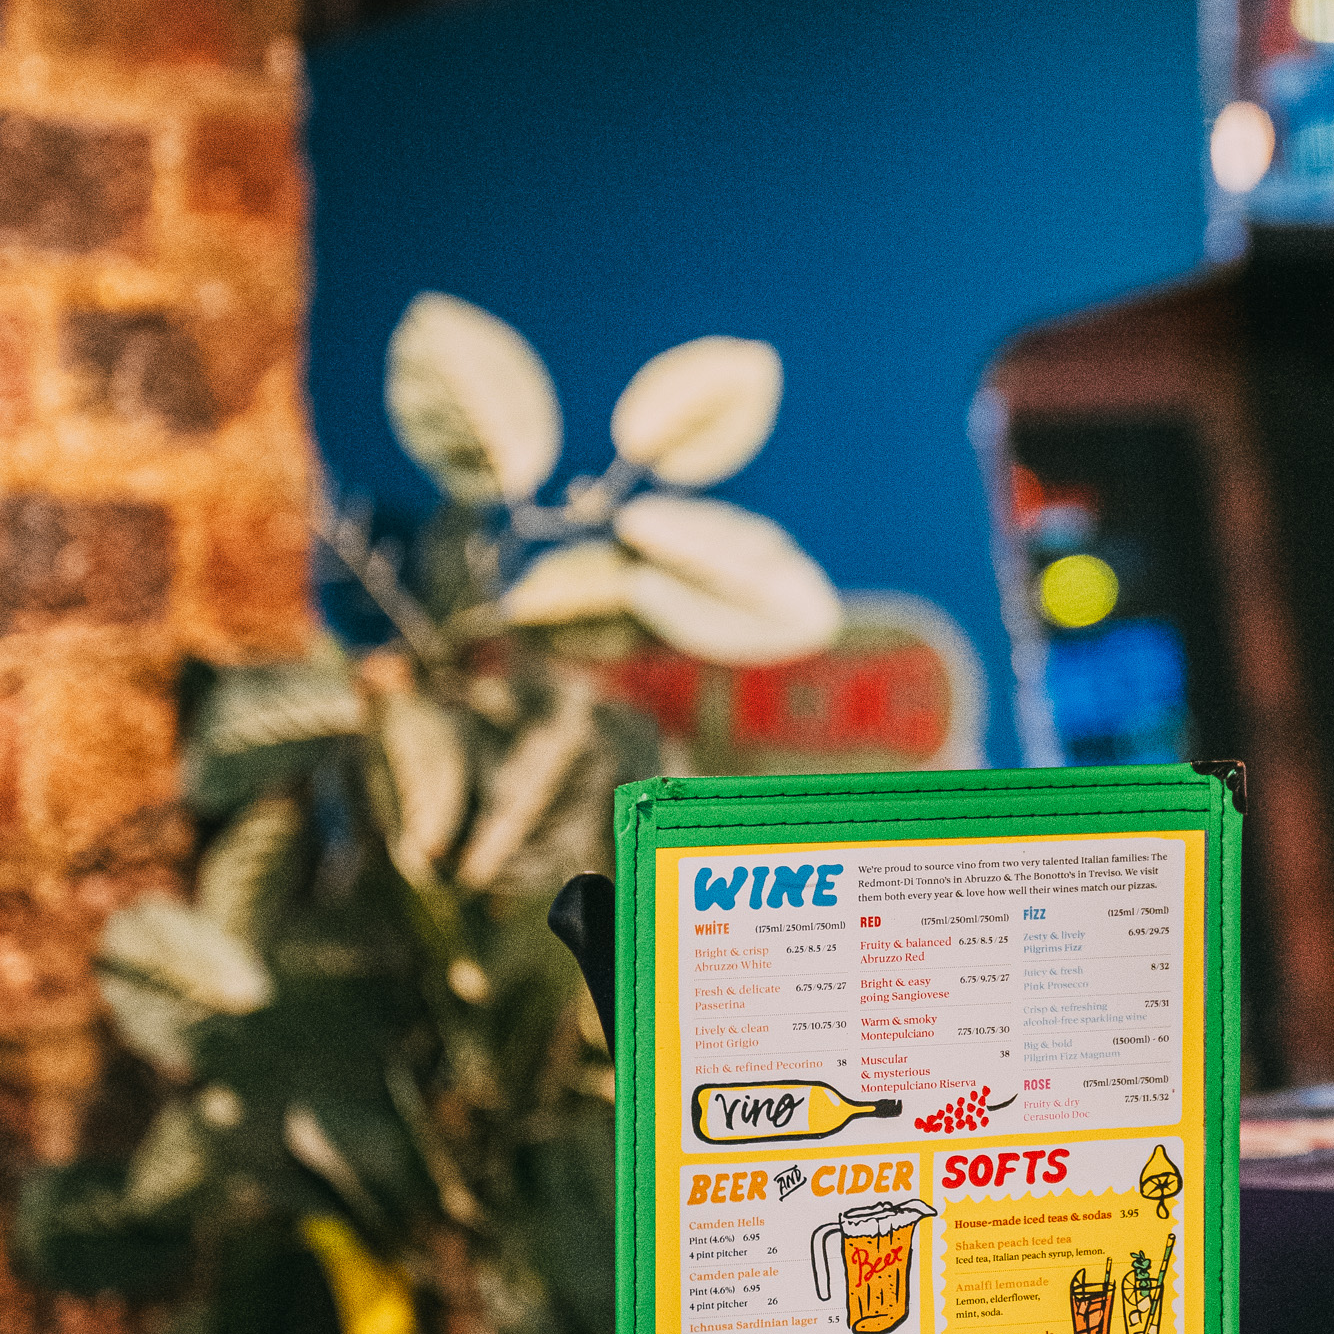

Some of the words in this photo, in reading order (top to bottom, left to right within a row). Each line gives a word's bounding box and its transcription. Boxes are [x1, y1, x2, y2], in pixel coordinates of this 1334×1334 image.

[884, 862, 911, 875] proud
[924, 863, 954, 871] source
[956, 861, 976, 869] vino
[978, 859, 1000, 869] from
[1020, 859, 1040, 868] very
[1042, 855, 1079, 866] talented
[1081, 855, 1109, 864] Italian
[1111, 853, 1149, 863] families:
[1150, 852, 1168, 861] The
[953, 875, 962, 884] in
[964, 874, 1002, 883] Abruzzo
[1003, 873, 1012, 882] &
[1014, 872, 1031, 881] The
[1077, 870, 1087, 878] in
[1088, 868, 1122, 878] Treviso.
[1124, 868, 1138, 876] We
[1139, 866, 1158, 875] visit
[694, 864, 843, 911] WINE
[857, 893, 882, 902] them
[884, 891, 906, 901] both
[907, 892, 932, 901] every
[934, 891, 953, 900] year
[954, 889, 964, 898] &
[966, 888, 985, 897] love
[987, 887, 1006, 896] how
[1008, 885, 1027, 895] well
[1029, 885, 1050, 894] their
[1052, 884, 1079, 893] wines
[1080, 882, 1109, 892] match
[1110, 883, 1126, 891] our
[1127, 881, 1157, 892] pizzas.
[860, 916, 882, 928] RED
[860, 940, 891, 951] Fruity
[893, 939, 903, 949] &
[905, 935, 952, 948] balanced
[860, 953, 903, 964] Abruzzo
[905, 950, 925, 962] Red
[860, 977, 892, 990] Bright
[895, 978, 905, 987] &
[907, 978, 931, 988] easy
[860, 992, 890, 1005] going
[891, 990, 950, 1002] Sangiovese
[860, 1017, 890, 1027] Warm
[891, 1016, 902, 1026] &
[903, 1013, 937, 1025] smoky
[861, 1028, 935, 1042] Montepulciano
[1112, 1034, 1150, 1045] (1500ml)
[1157, 1034, 1170, 1043] 60
[836, 1058, 847, 1067] 38
[861, 1053, 908, 1065] Muscular
[1000, 1049, 1010, 1058] 38
[860, 1070, 871, 1080] &
[873, 1067, 931, 1080] mysterious
[861, 1080, 937, 1093] Montepulciano
[939, 1079, 976, 1089] Riserva
[1024, 1079, 1051, 1091] ROSE
[715, 1093, 805, 1130] vino
[942, 1149, 1070, 1190] SOFTS
[687, 1170, 768, 1206] BEER
[777, 1168, 802, 1195] AND
[811, 1160, 914, 1197] CIDER
[688, 1218, 734, 1230] Camden
[737, 1216, 765, 1228] Hells
[954, 1215, 1021, 1229] House-made
[1023, 1213, 1045, 1225] iced
[1047, 1214, 1068, 1223] teas
[1070, 1212, 1081, 1222] &
[1082, 1209, 1112, 1221] sodas
[1120, 1208, 1139, 1218] 3.95
[689, 1236, 707, 1245] Pint
[709, 1234, 735, 1244] (4.6%)
[742, 1232, 760, 1242] 6.95
[689, 1251, 695, 1260] 4
[696, 1250, 714, 1261] pint
[716, 1248, 747, 1260] pitcher
[767, 1246, 778, 1255] 26
[955, 1254, 974, 1265] Iced
[992, 1252, 1020, 1262] Italian
[1021, 1250, 1047, 1262] peach
[1048, 1250, 1074, 1259] syrup,
[1075, 1248, 1105, 1256] lemon.
[689, 1270, 735, 1281] Camden
[737, 1267, 761, 1281] pale
[762, 1266, 779, 1277] ale
[852, 1246, 903, 1288] Beer
[955, 1297, 989, 1306] Lemon,
[989, 1292, 1040, 1304] elderflower,
[955, 1310, 979, 1319] mint,
[980, 1307, 1003, 1317] soda.
[689, 1322, 733, 1333] Ichnusa
[735, 1318, 788, 1330] Sardinian
[791, 1316, 818, 1327] lager
[828, 1315, 840, 1324] 5.5
